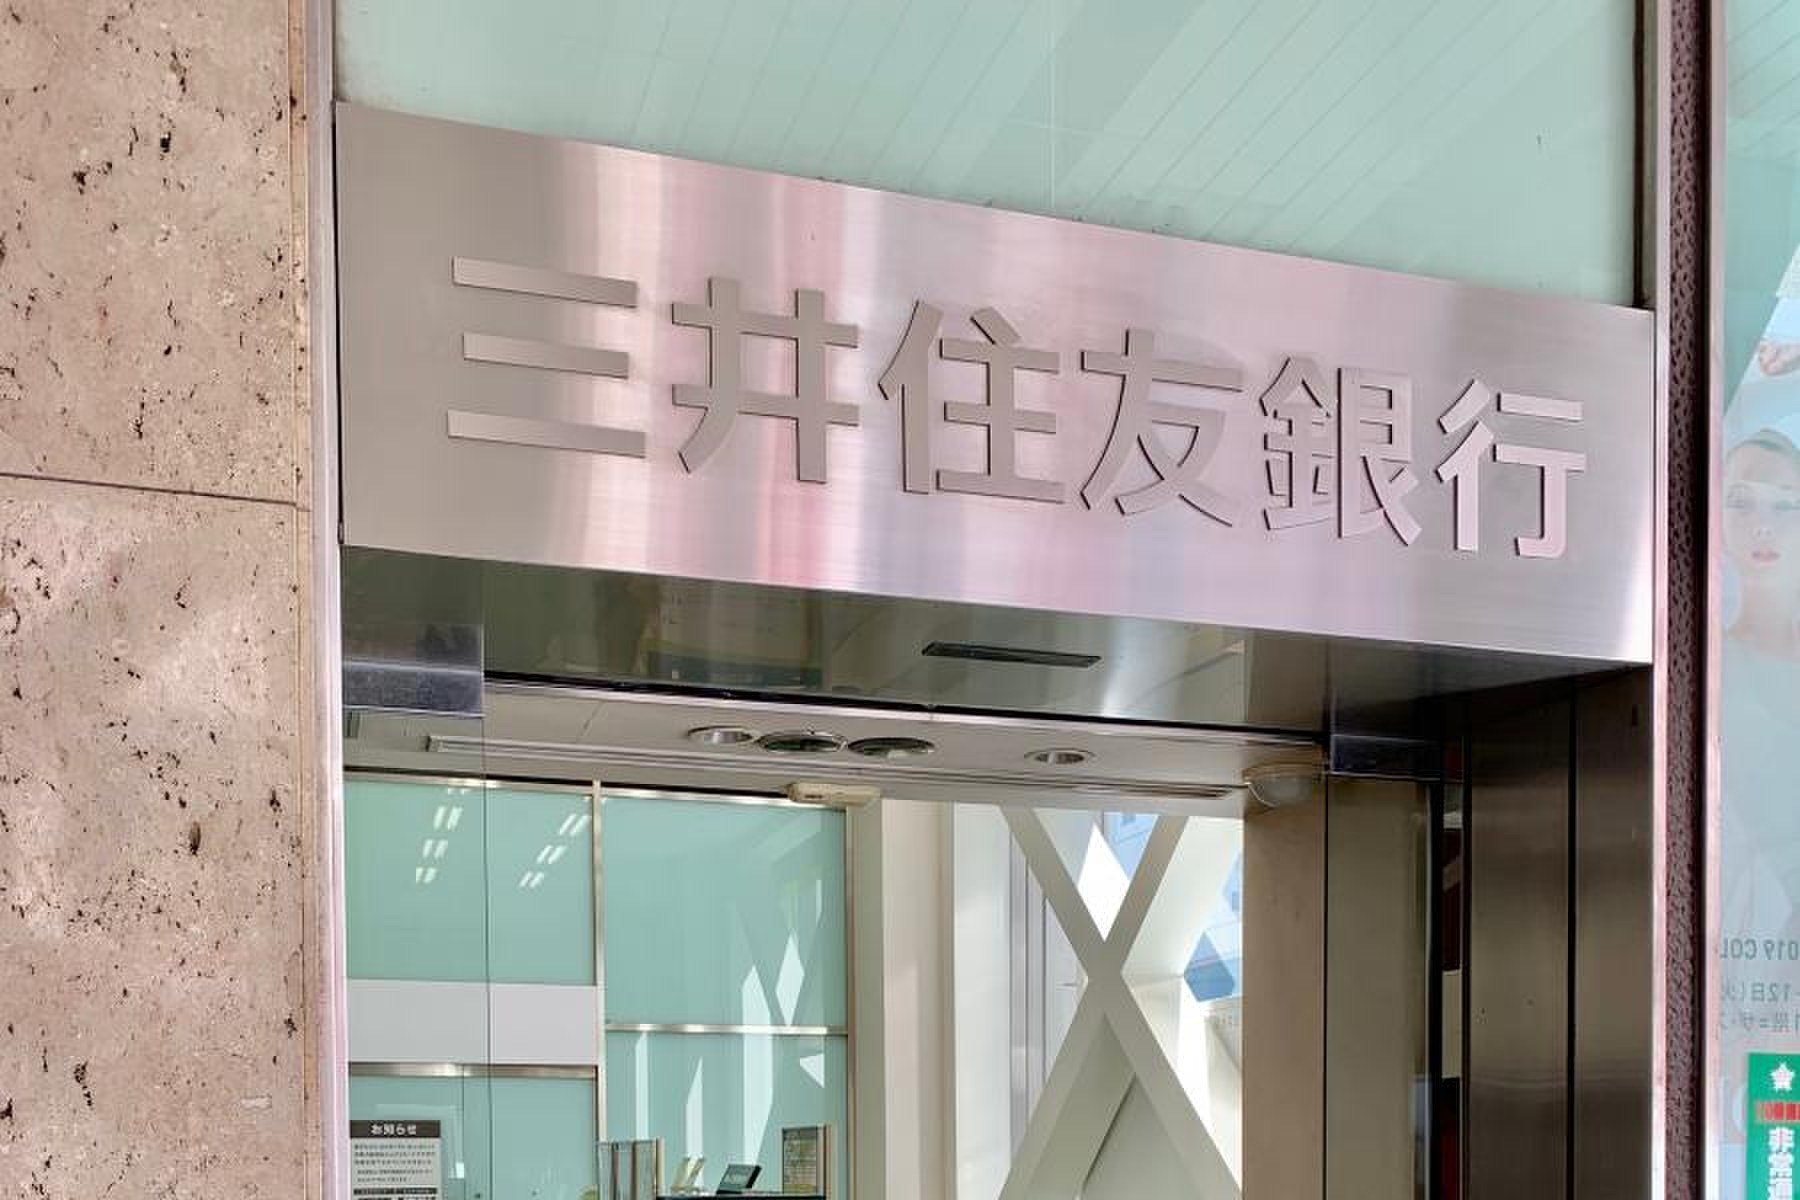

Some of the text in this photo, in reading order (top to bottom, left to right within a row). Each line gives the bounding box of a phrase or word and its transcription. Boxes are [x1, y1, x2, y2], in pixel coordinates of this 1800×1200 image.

[447, 255, 1587, 560] 三井住友銀行
[371, 1123, 417, 1136] お知らせ
